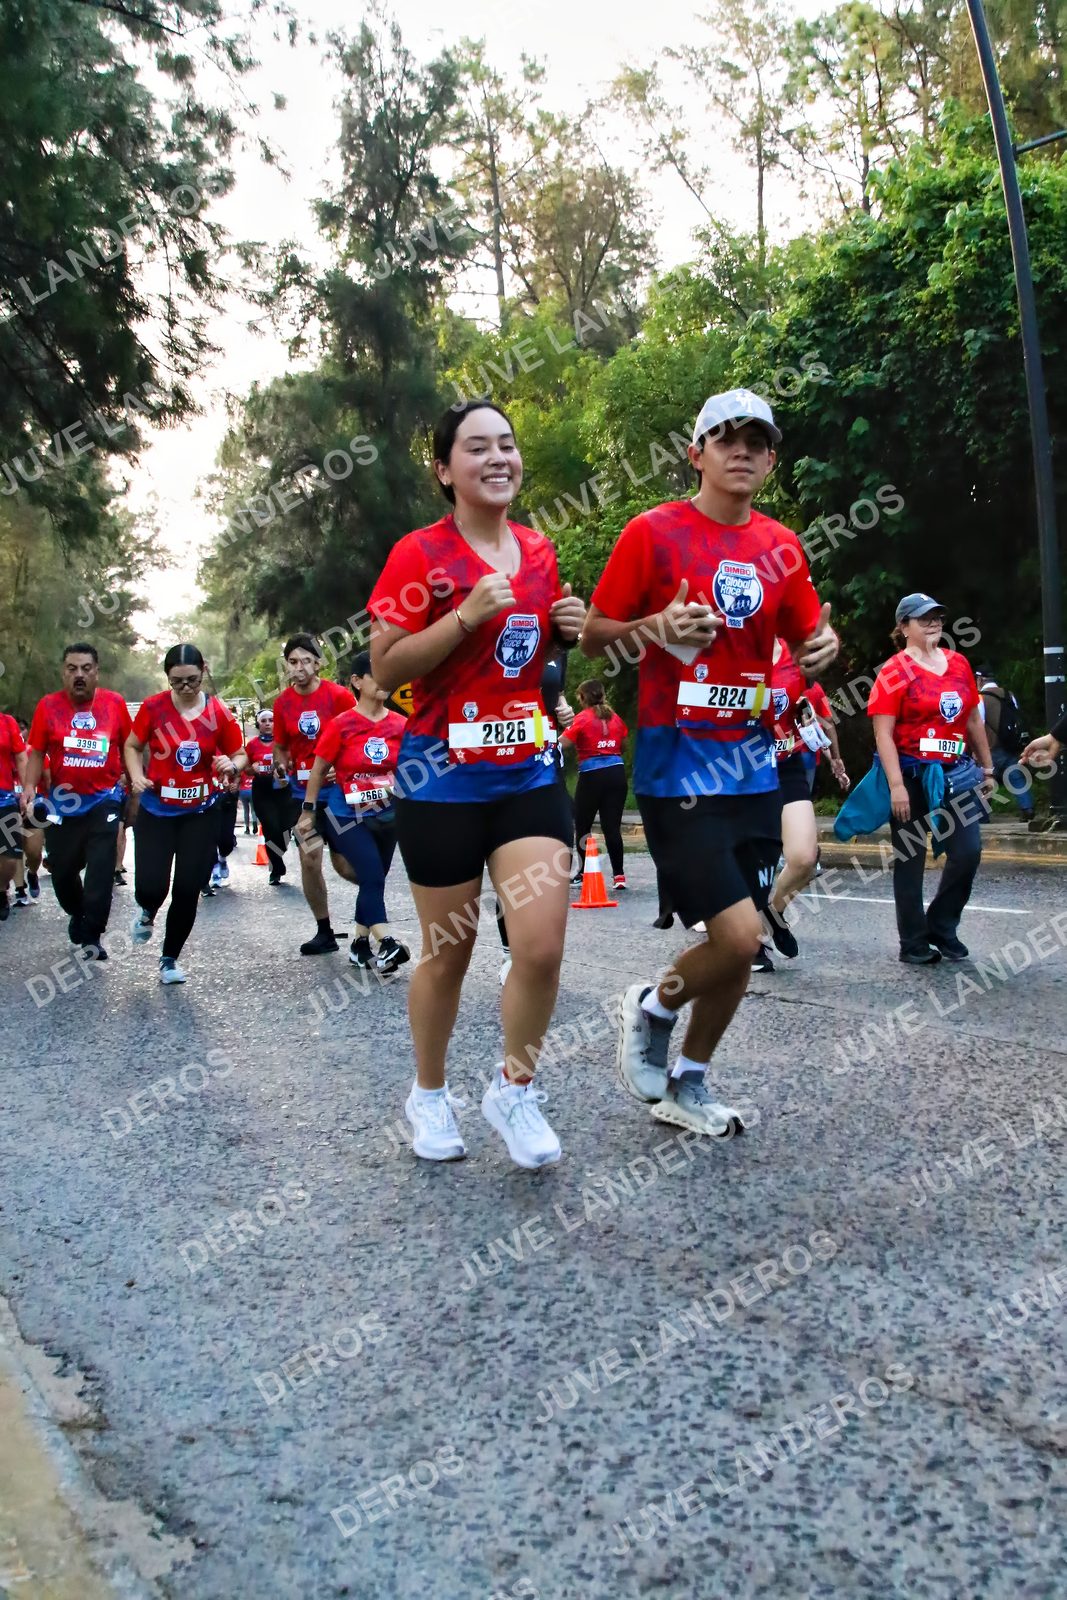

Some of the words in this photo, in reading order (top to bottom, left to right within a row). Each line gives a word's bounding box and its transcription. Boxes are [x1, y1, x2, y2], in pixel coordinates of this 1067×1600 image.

[724, 566, 751, 576] BIMBO
[725, 576, 752, 589] Global
[720, 584, 742, 596] Race
[510, 619, 535, 628] BIMBO
[708, 686, 748, 708] 2824
[482, 720, 526, 745] 2826
[77, 739, 97, 749] 3399
[938, 740, 956, 752] 1879
[177, 788, 197, 799] 1622
[360, 789, 383, 802] 2666
